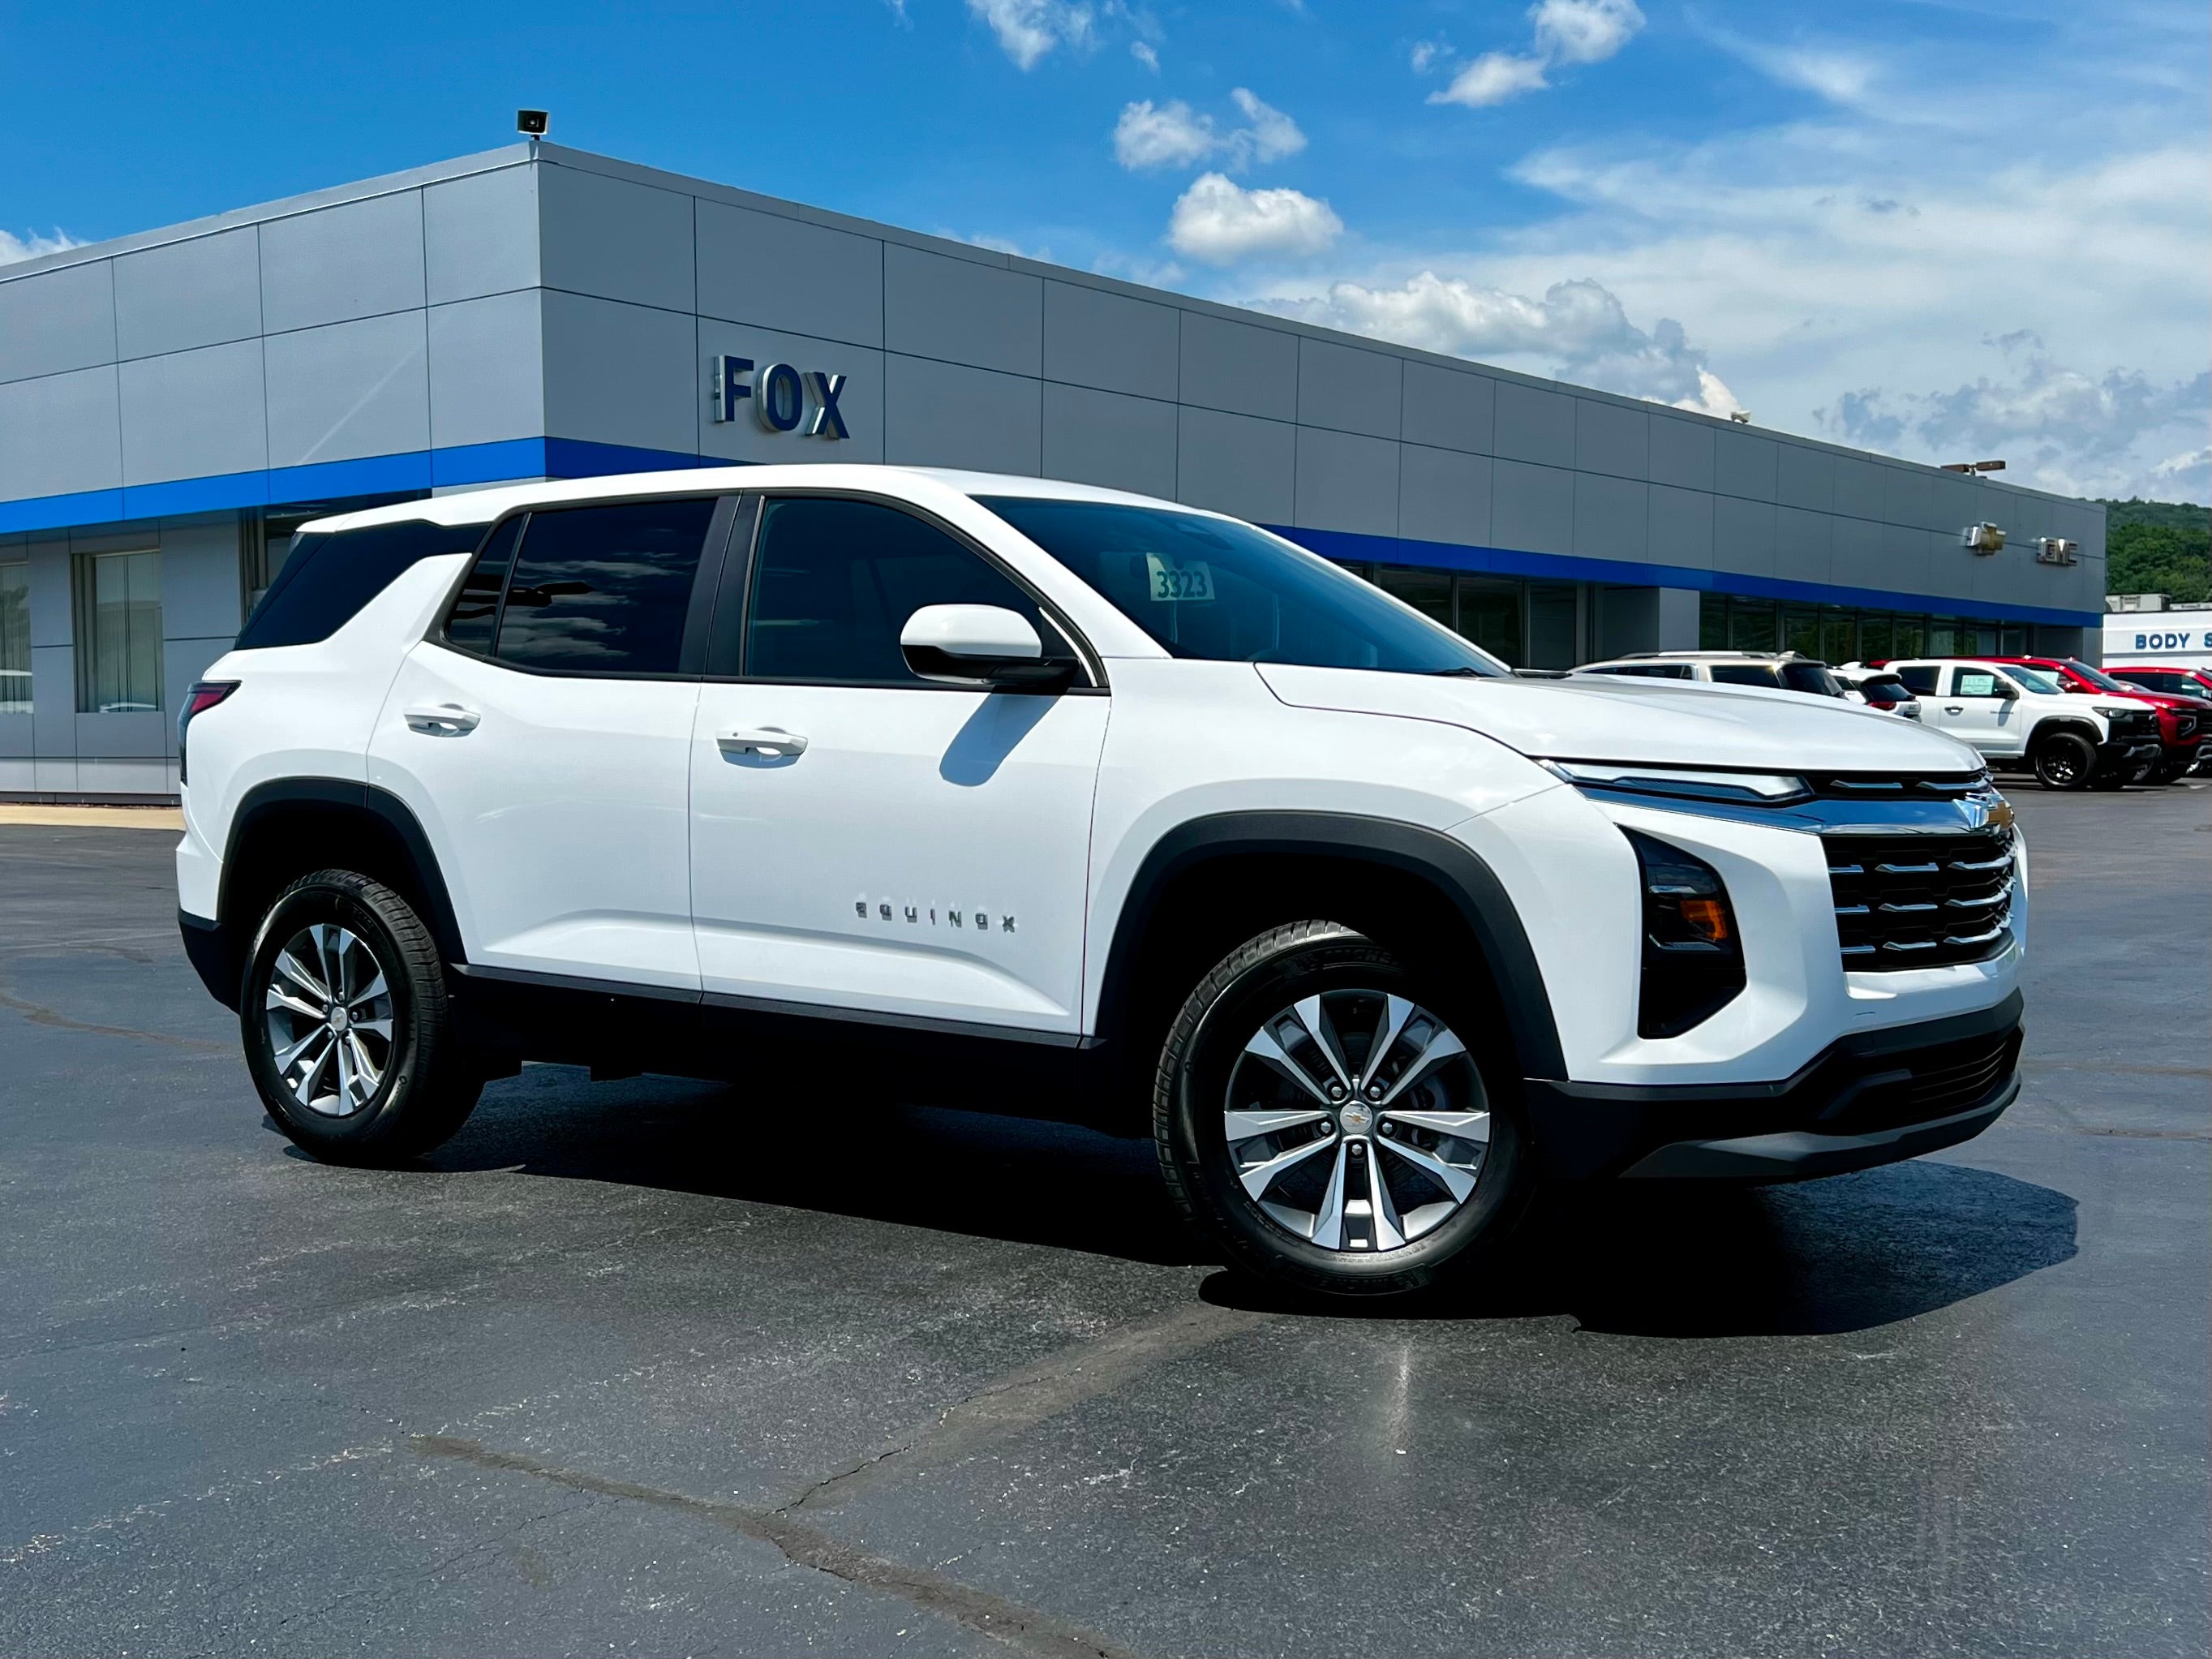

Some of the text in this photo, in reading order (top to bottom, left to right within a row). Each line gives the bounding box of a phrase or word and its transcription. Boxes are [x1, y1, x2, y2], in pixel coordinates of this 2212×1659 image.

[714, 355, 850, 439] FOX
[2038, 537, 2078, 566] GMC
[1157, 571, 1207, 598] 3323
[2136, 633, 2190, 650] BODY
[856, 902, 1015, 932] EQUINOX
